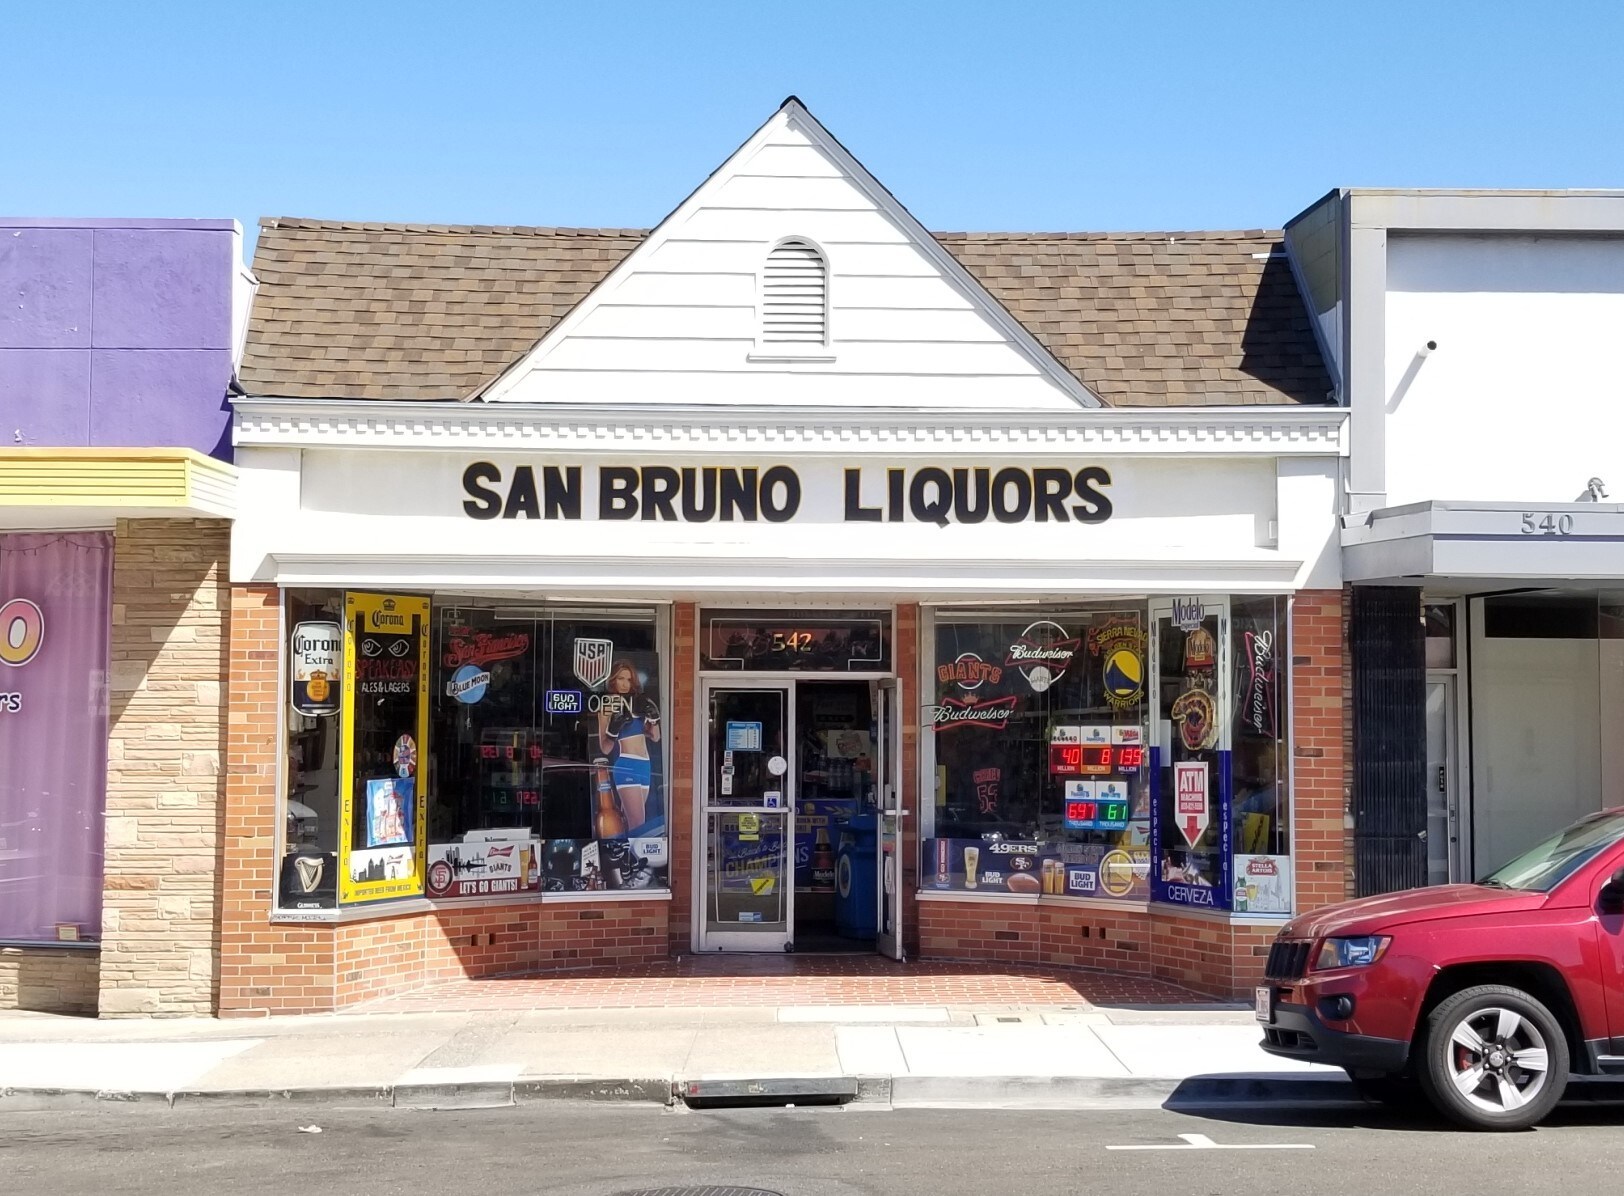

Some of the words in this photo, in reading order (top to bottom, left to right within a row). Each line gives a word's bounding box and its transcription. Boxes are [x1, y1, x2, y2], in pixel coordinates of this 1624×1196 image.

[463, 462, 581, 520] SAN
[600, 465, 801, 523] BRUNO
[843, 466, 1113, 528] LIQUORS
[1521, 513, 1574, 535] 540
[371, 610, 404, 629] Corona
[1172, 596, 1205, 625] Modelo
[771, 631, 812, 653] 542
[1096, 626, 1123, 644] SIERRA
[1123, 626, 1148, 643] NEVAD
[294, 635, 341, 657] Coron
[579, 642, 605, 659] USA
[1010, 644, 1074, 660] Budweiser
[304, 653, 334, 665] Extra
[346, 619, 354, 692] Corona
[355, 659, 417, 681] SPEAKEASY
[937, 661, 1003, 684] GIANTS
[451, 680, 470, 693] BLUE
[471, 674, 489, 687] MOON
[1253, 630, 1272, 734] Budweiser
[549, 701, 578, 711] LIGHT
[553, 693, 575, 703] BUD
[588, 694, 633, 715] OPEN
[1103, 687, 1145, 709] WARRIORS
[931, 705, 1013, 723] Budweiser
[1062, 749, 1080, 764] 40
[1101, 749, 1110, 764] 8
[1180, 770, 1204, 792] ATM
[1107, 804, 1126, 820] 61
[989, 843, 1038, 854] 49ERS
[489, 862, 512, 874] GIANTS
[1015, 857, 1030, 870] SF
[1071, 880, 1094, 889] LIGHT
[1074, 872, 1091, 880] BUD
[459, 881, 477, 894] LET'S
[479, 880, 490, 893] GO
[491, 878, 518, 893] GIANTS!
[1168, 885, 1214, 906] CERVEZA
